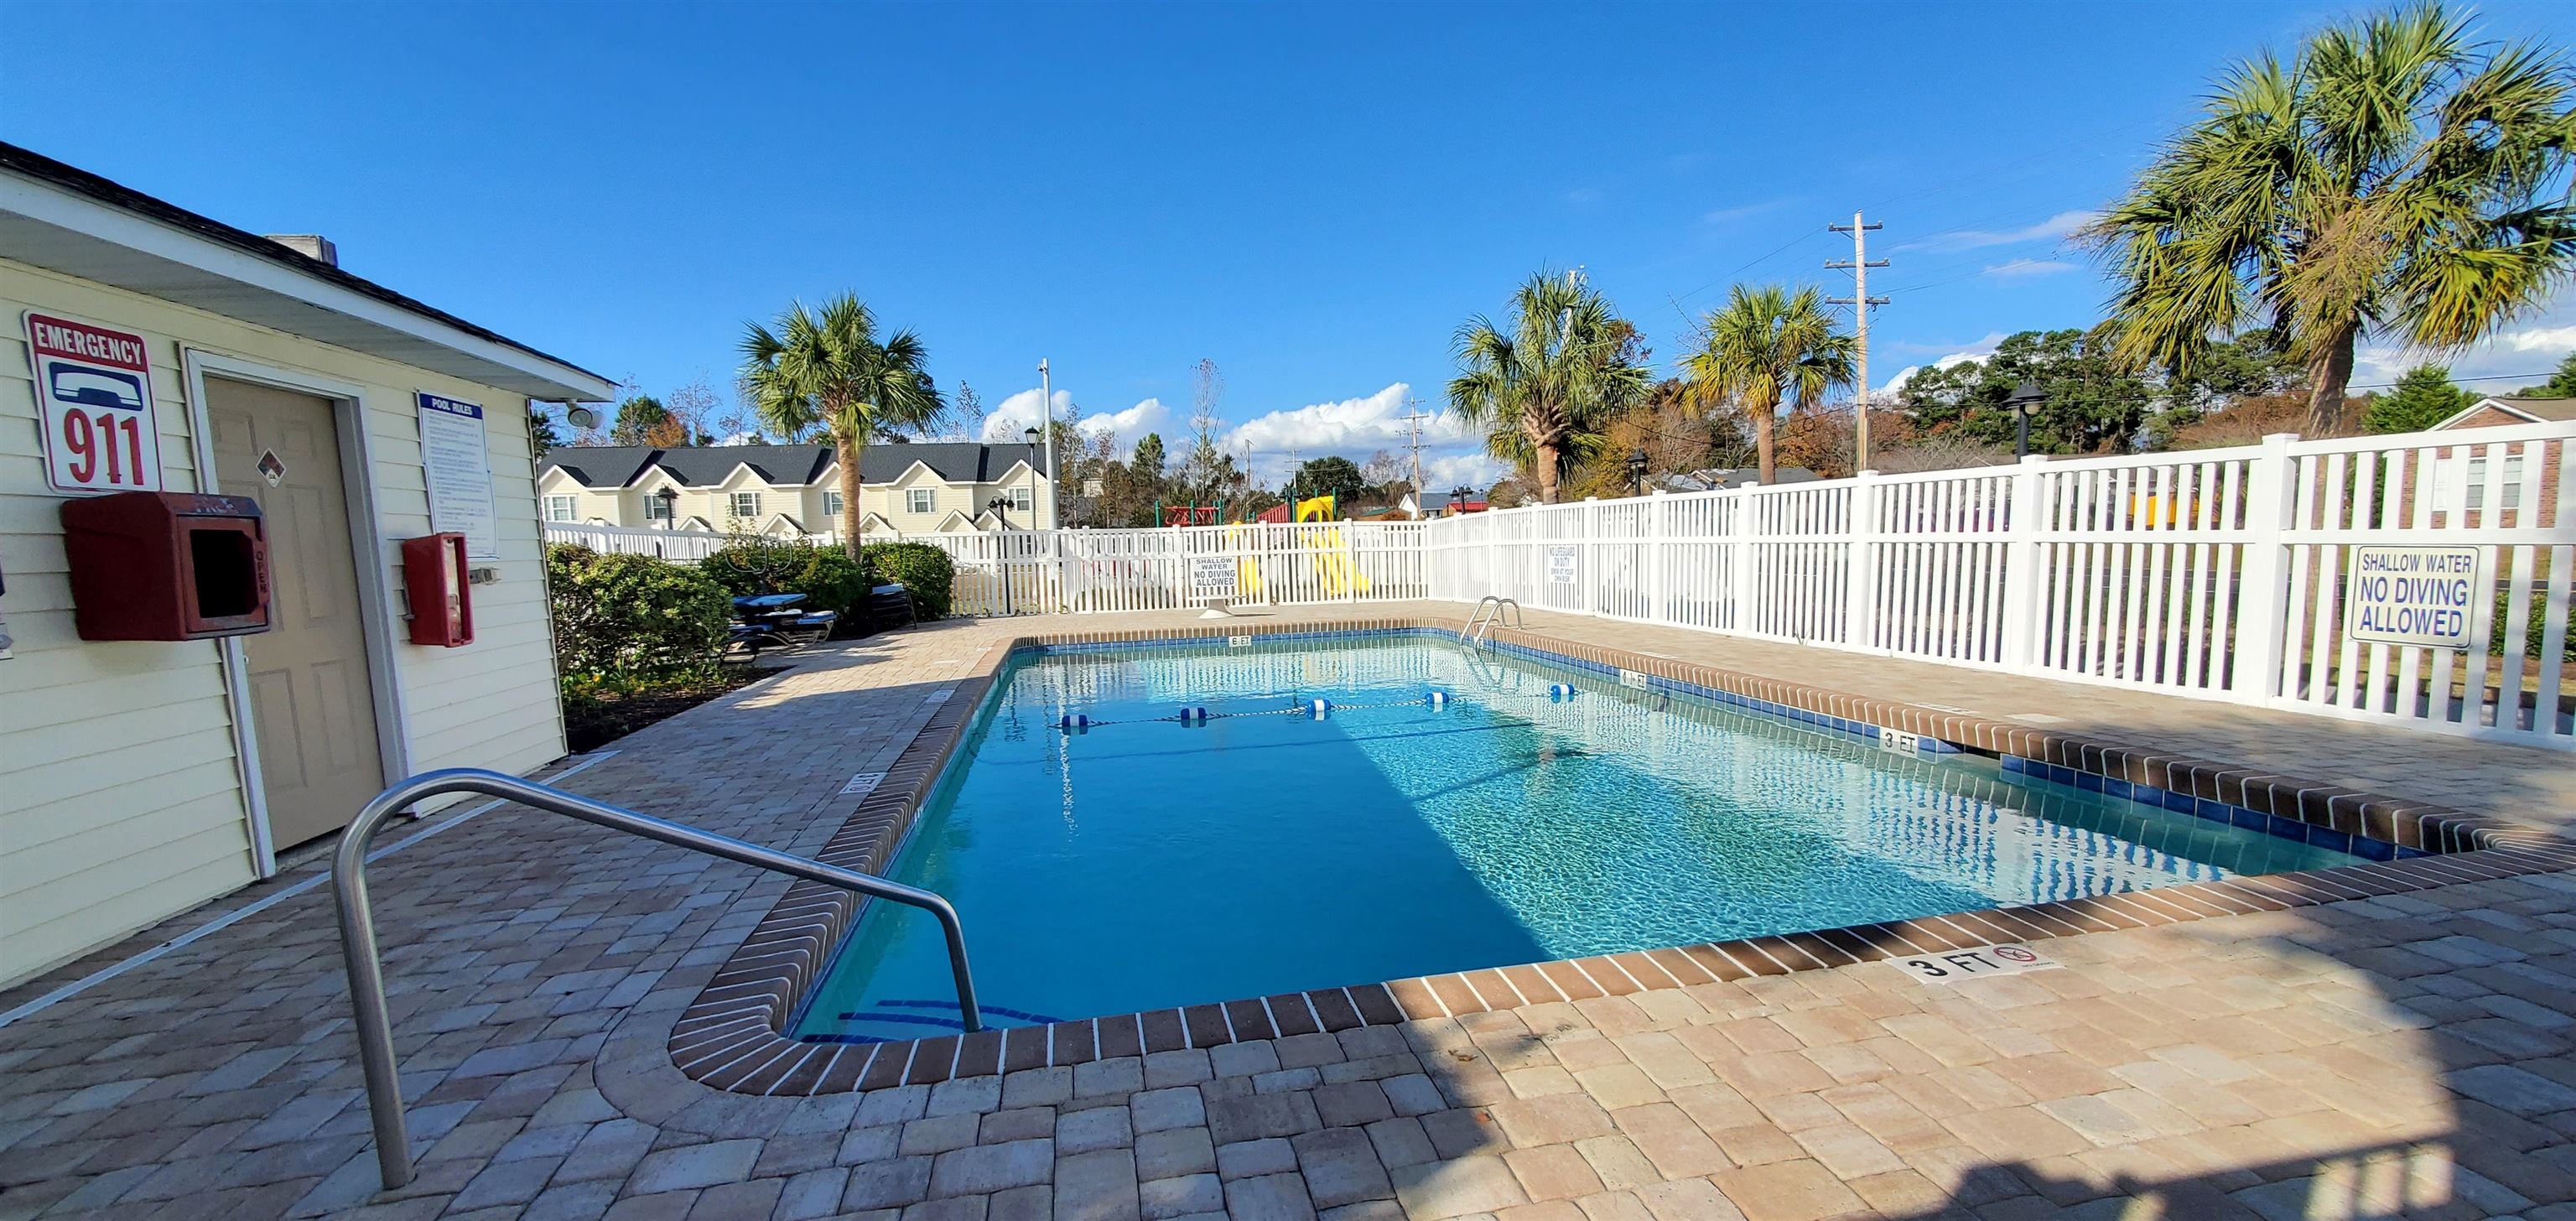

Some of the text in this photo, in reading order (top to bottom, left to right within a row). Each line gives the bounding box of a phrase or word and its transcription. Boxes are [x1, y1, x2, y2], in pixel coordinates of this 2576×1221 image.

[34, 322, 142, 365] EMERGENCY
[431, 397, 473, 416] POOL RULES
[64, 408, 144, 486] 911
[1208, 570, 1235, 579] DIVING
[2362, 553, 2471, 574] SHALLOW WATER
[1197, 578, 1234, 586] ALLOWED
[2360, 576, 2468, 606] NO DIVING
[2359, 605, 2463, 637] ALLOWED
[1885, 732, 1893, 748] 3
[1908, 952, 2001, 977] 3 FT
